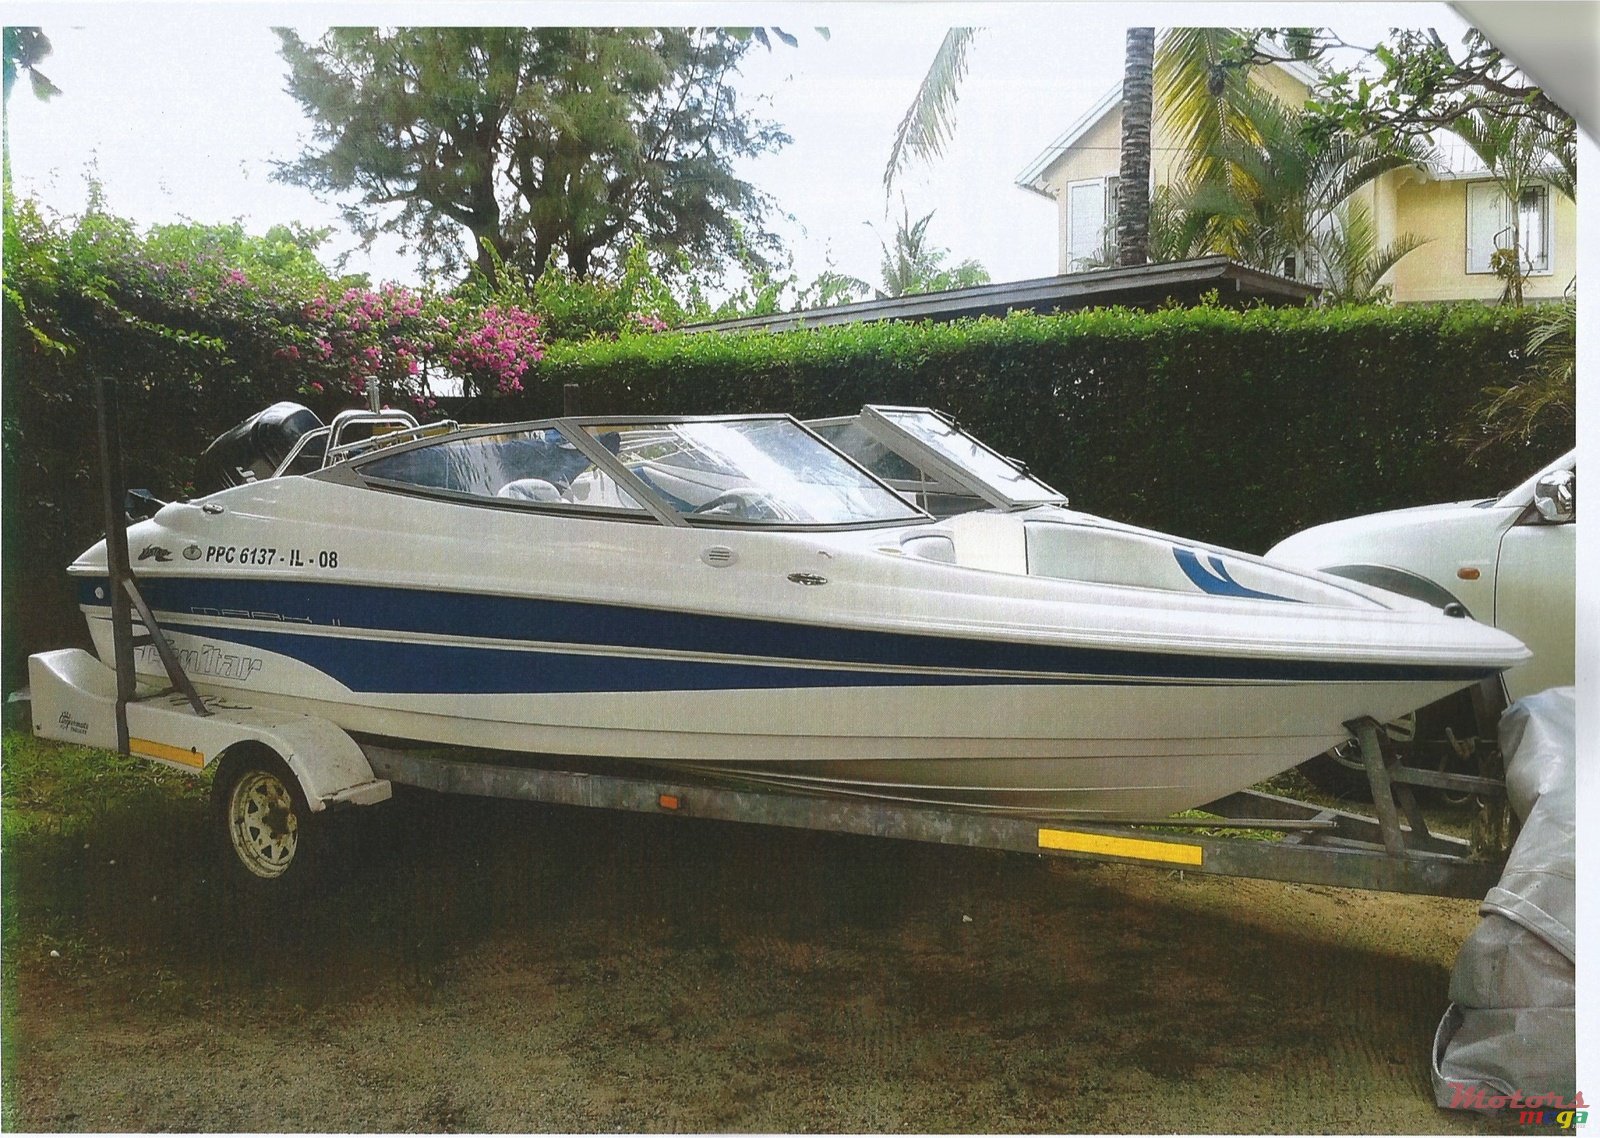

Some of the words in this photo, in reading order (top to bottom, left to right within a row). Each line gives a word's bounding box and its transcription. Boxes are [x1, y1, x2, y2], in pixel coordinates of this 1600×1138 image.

[206, 545, 236, 564] PPC
[239, 547, 277, 566] 6137
[289, 549, 304, 567] IL
[318, 550, 338, 569] 08
